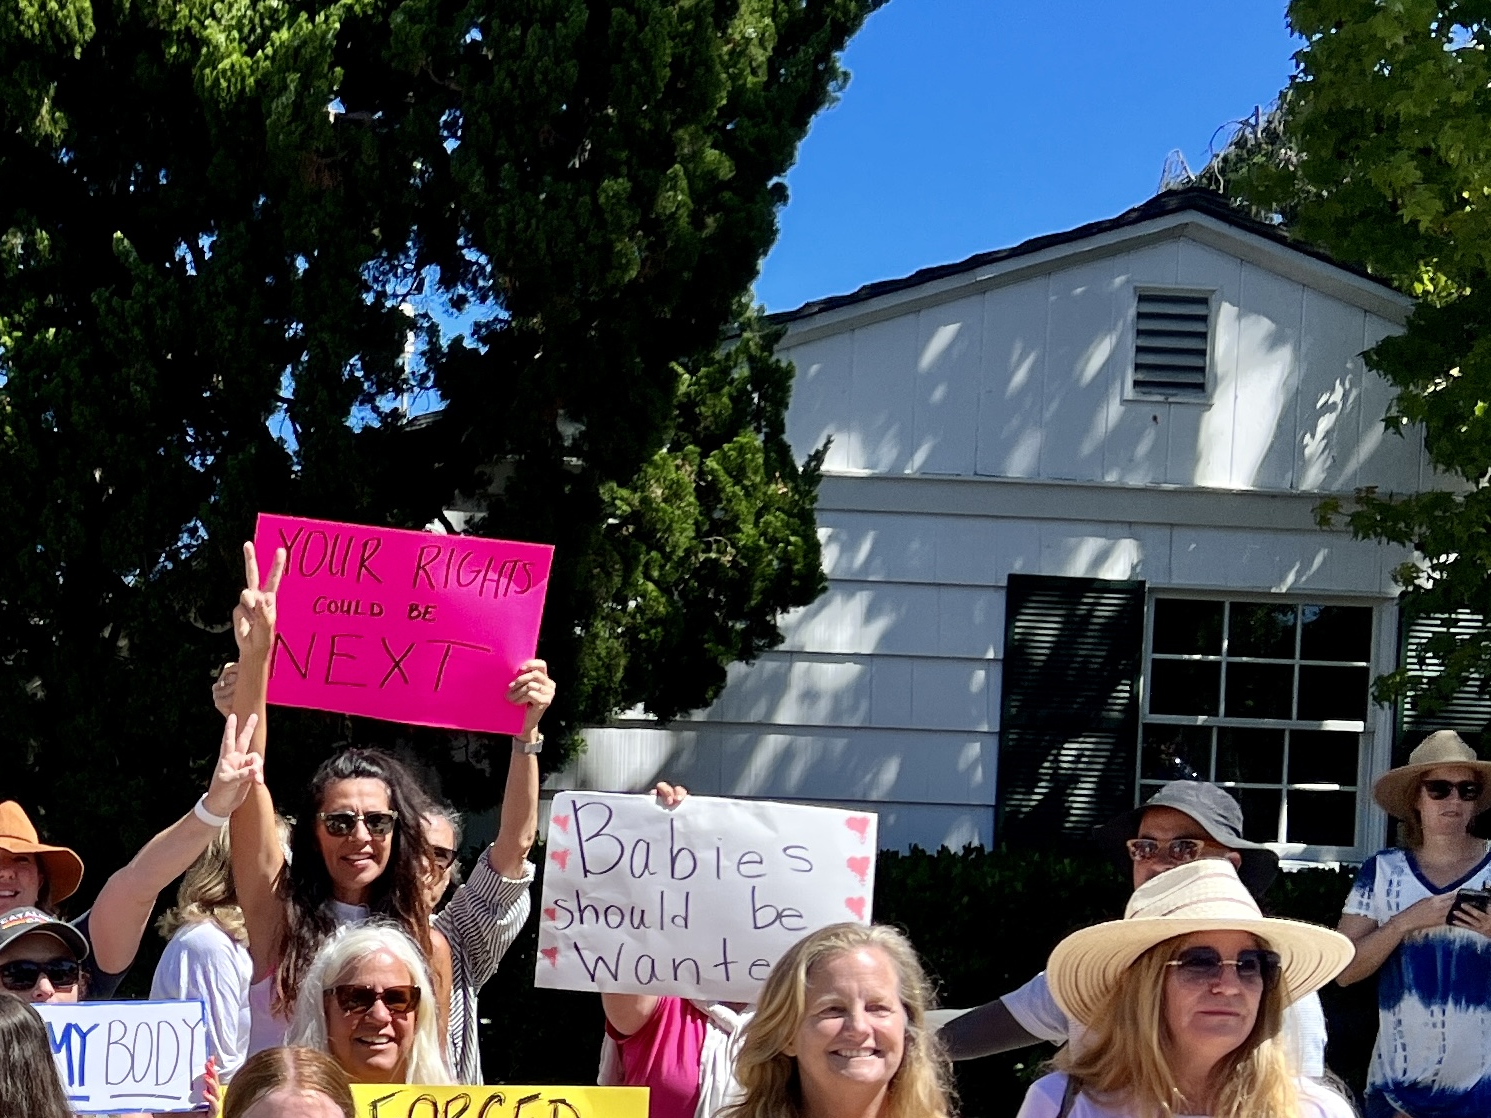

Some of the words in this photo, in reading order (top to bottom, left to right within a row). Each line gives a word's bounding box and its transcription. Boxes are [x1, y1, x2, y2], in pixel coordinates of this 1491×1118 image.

[279, 527, 383, 585] YOUR
[413, 544, 535, 599] RIGHTS
[313, 596, 384, 617] COULD
[408, 603, 436, 623] BE
[269, 632, 492, 692] NEXT
[572, 800, 813, 880] Babies
[554, 889, 690, 931] should
[752, 886, 808, 930] be
[573, 938, 770, 985] Wante
[46, 1022, 100, 1087] MY
[105, 1018, 203, 1091] BODY
